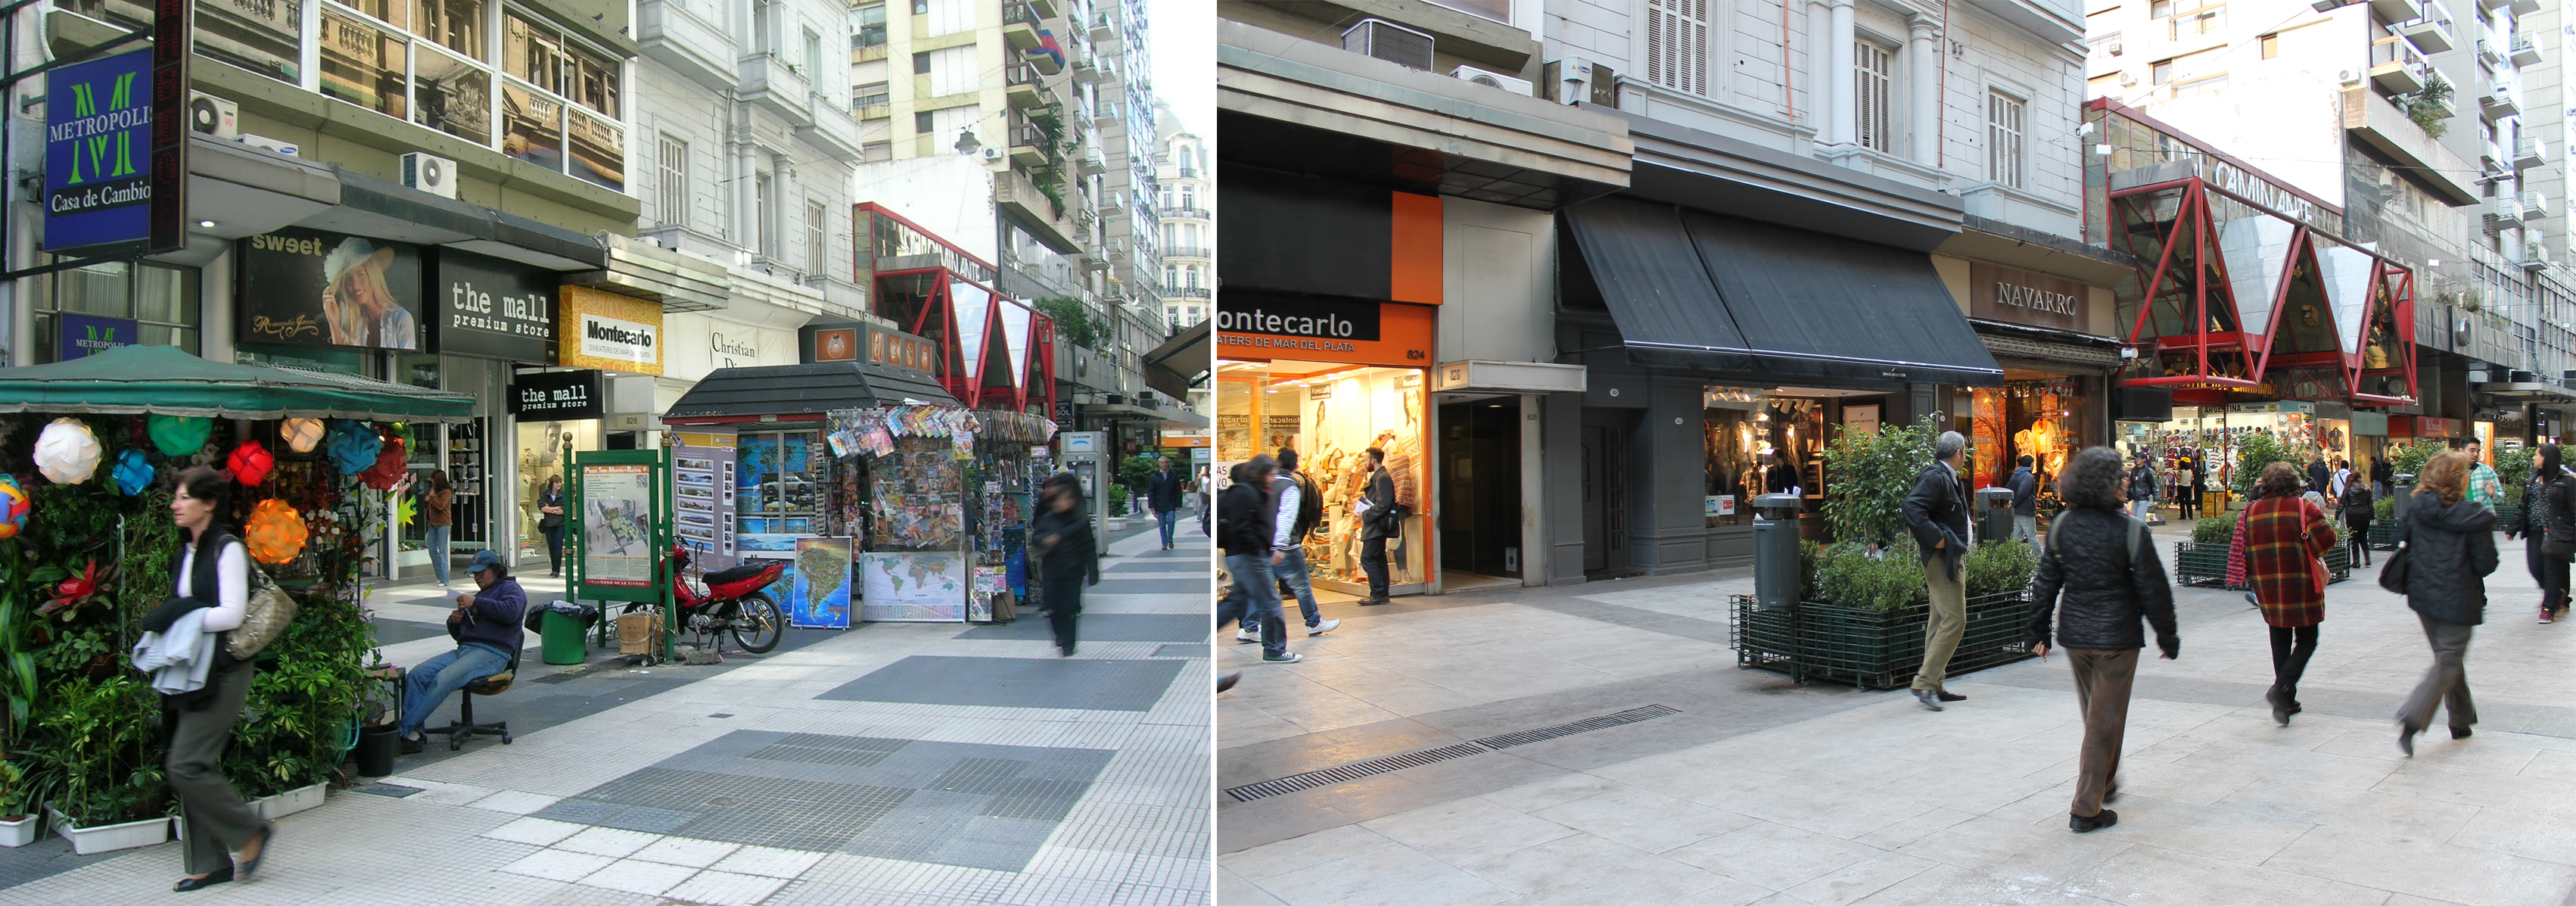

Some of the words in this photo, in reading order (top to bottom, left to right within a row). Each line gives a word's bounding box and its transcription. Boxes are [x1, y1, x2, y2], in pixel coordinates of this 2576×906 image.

[51, 194, 79, 213] Casa
[83, 188, 98, 207] de
[101, 181, 151, 204] Cambio
[2216, 160, 2313, 224] CAMINANTE
[251, 234, 322, 257] sweet
[452, 282, 491, 314] the
[502, 294, 550, 324] mall
[1996, 282, 2077, 316] NAVARRO
[453, 314, 508, 332] premium
[515, 322, 549, 338] store
[587, 320, 652, 347] Montecarlo
[76, 338, 125, 348] METROPOLIS
[589, 344, 612, 354] SWEATERS
[712, 332, 755, 357] Christian
[1255, 337, 1270, 347] DE
[1273, 338, 1298, 350] MAR
[1300, 341, 1321, 350] DEL
[1324, 341, 1355, 353] PLATA
[1407, 349, 1425, 360] 824
[1450, 369, 1461, 381] 826
[521, 388, 546, 403] the
[553, 385, 587, 401] mall
[522, 402, 557, 411] premium
[1965, 436, 1992, 444] AVARRO
